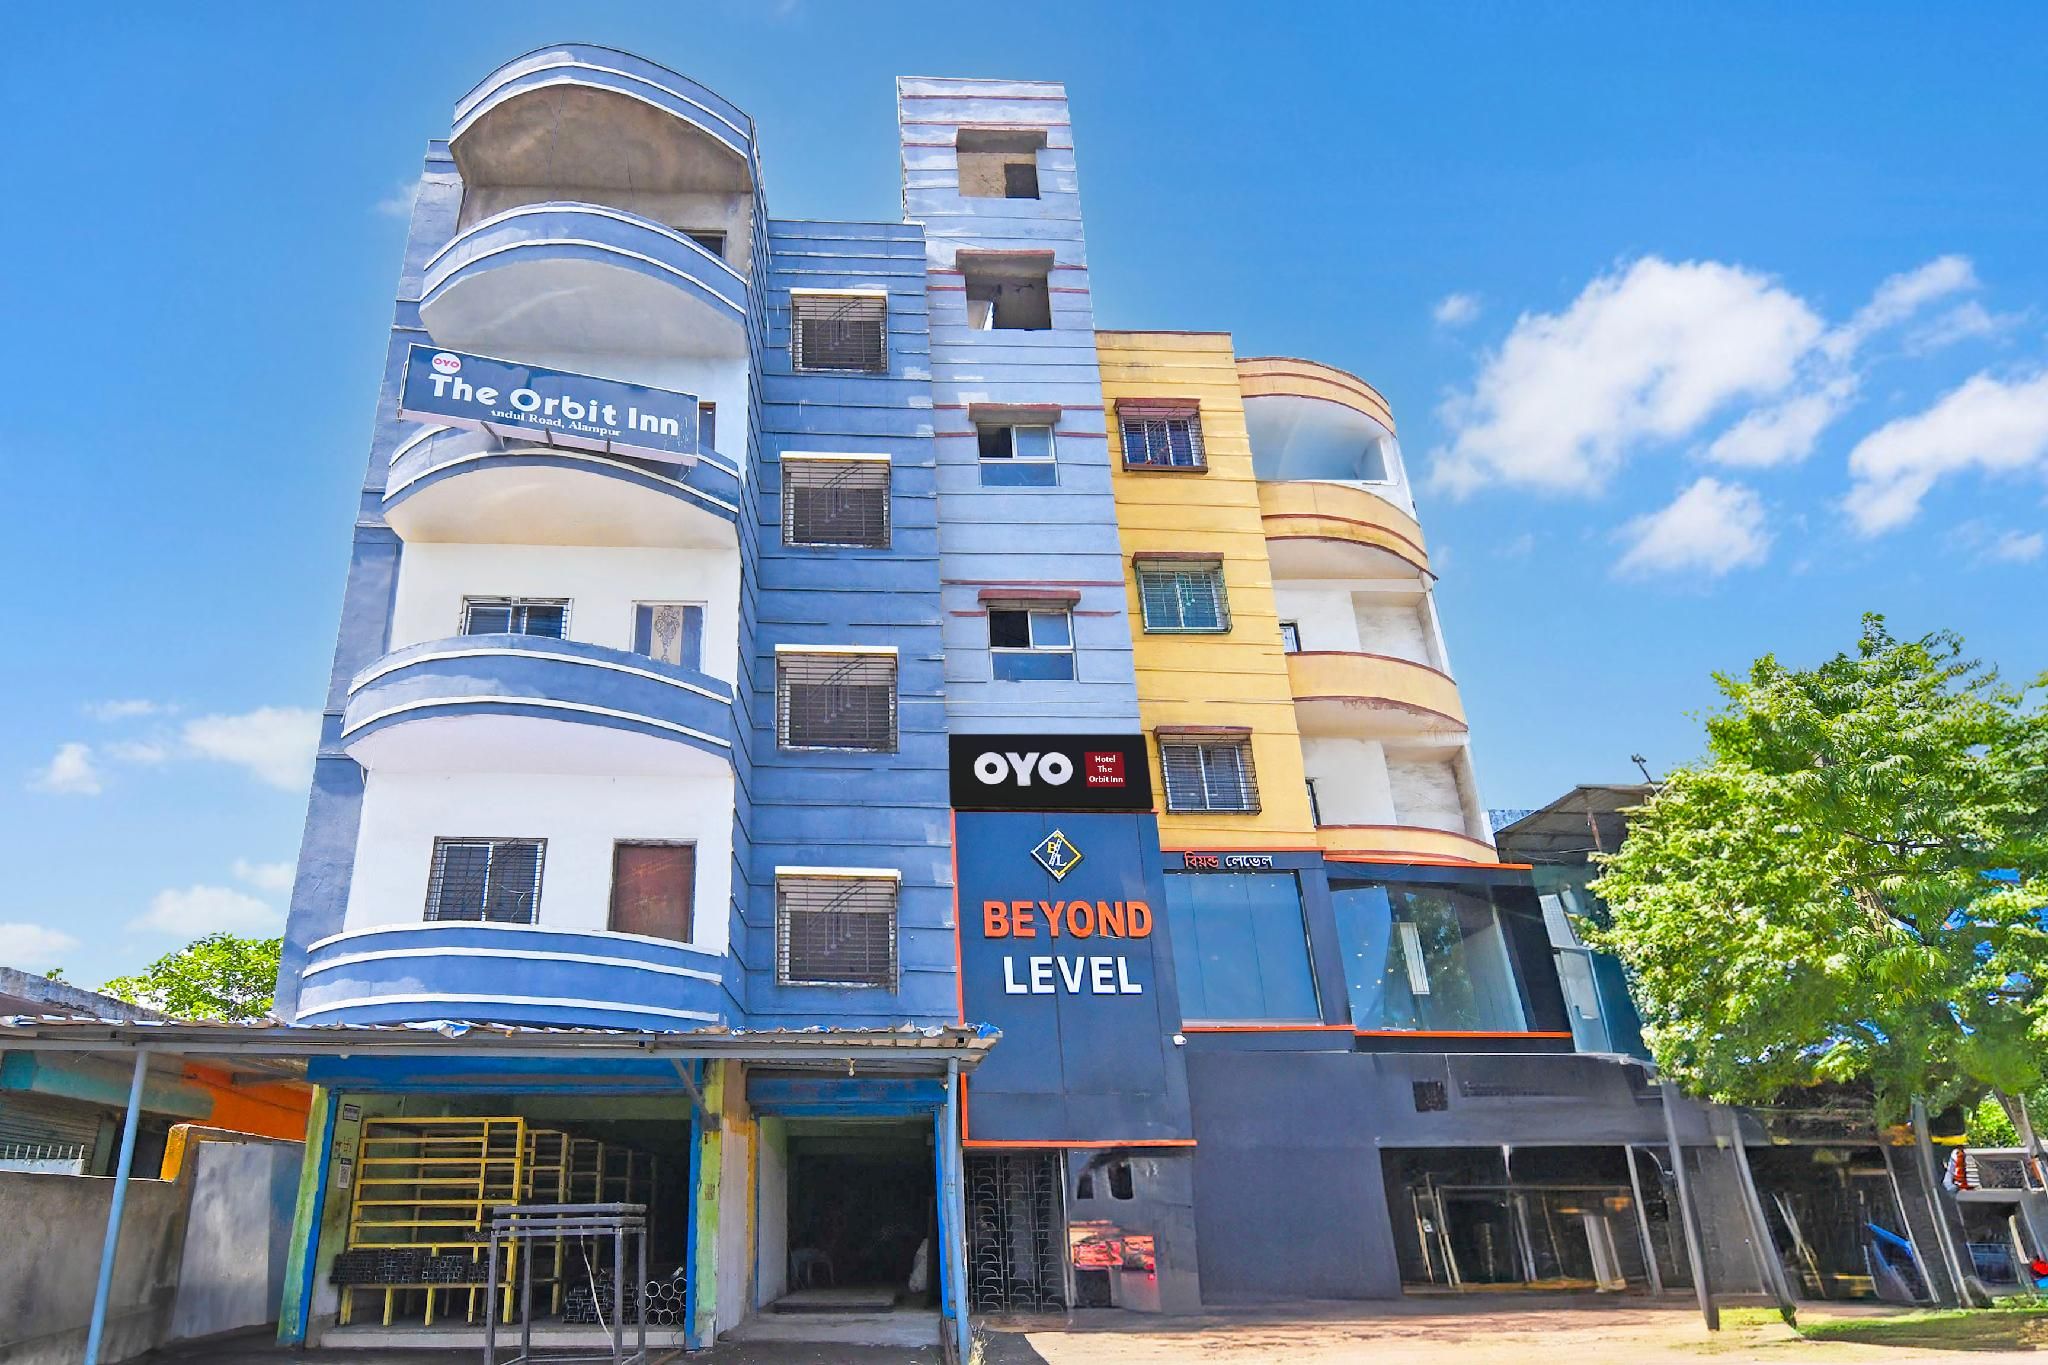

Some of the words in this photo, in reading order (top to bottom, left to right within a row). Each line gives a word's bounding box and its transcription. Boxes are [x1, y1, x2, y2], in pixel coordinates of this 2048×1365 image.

[433, 357, 460, 368] OYO
[428, 373, 499, 406] The
[510, 388, 617, 426] Orbit
[628, 407, 679, 436] Inn
[529, 414, 565, 429] Road,
[568, 420, 621, 436] Alampur
[1095, 754, 1116, 763] Hotel
[974, 751, 1073, 786] OYO
[1097, 765, 1113, 773] The
[1088, 775, 1110, 783] Orbit
[1110, 775, 1124, 783] Inn
[1225, 855, 1272, 867] লেভেল
[983, 900, 1153, 938] BEYOND
[1003, 956, 1143, 994] LEVEL
